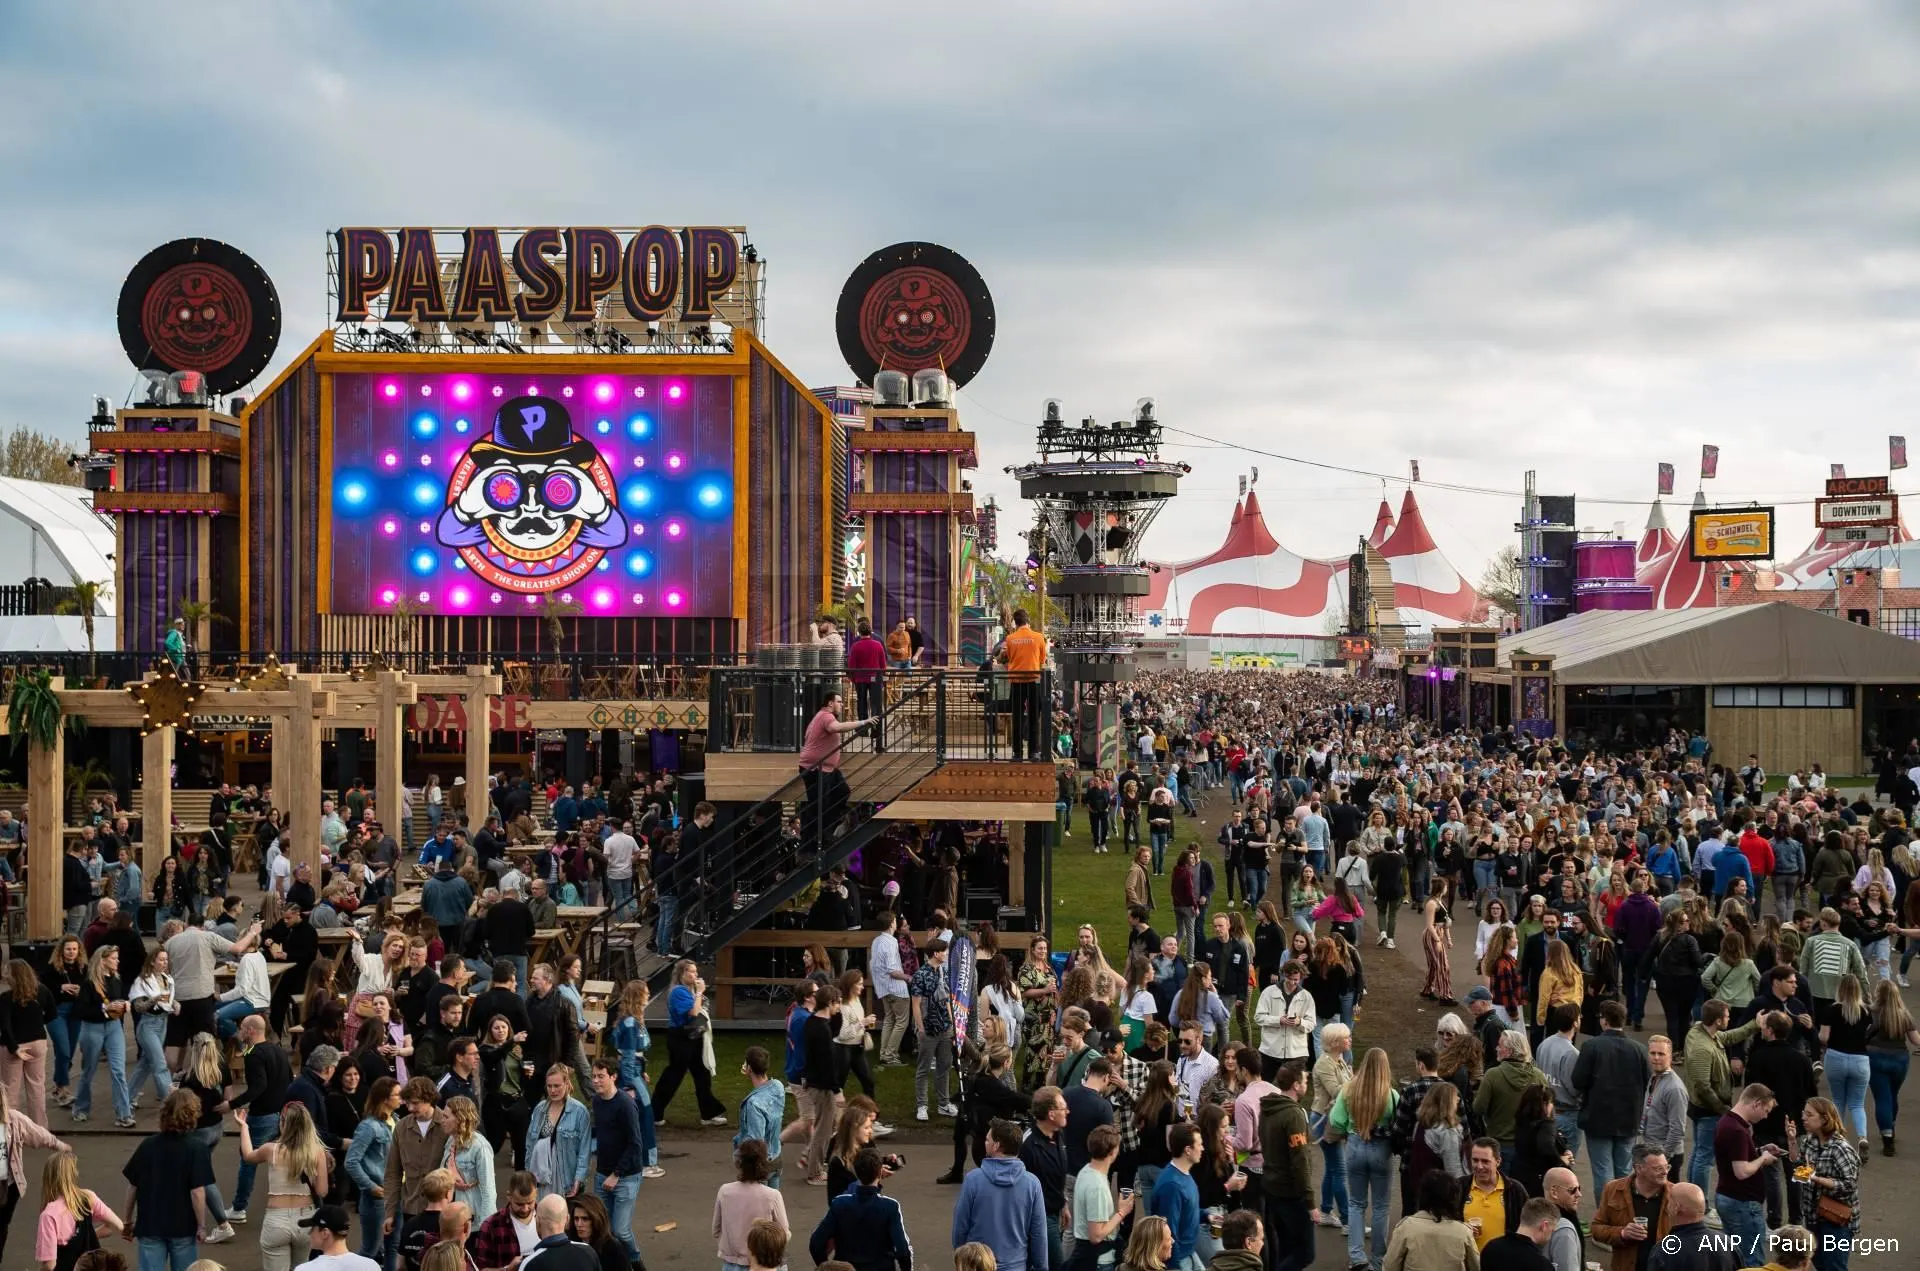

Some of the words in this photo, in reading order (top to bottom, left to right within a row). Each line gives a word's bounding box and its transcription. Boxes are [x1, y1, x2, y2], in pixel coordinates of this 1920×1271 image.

[335, 225, 738, 322] PAASPOP
[520, 405, 547, 444] P
[453, 457, 475, 497] REATEST
[1829, 480, 1886, 492] ARCADE
[1832, 505, 1881, 517] DOWNTOWN
[1717, 523, 1753, 537] SCHIJNDEL
[1846, 530, 1866, 540] OPEN
[464, 547, 486, 571] ARTH
[493, 572, 512, 585] THE
[513, 578, 561, 589] GREATEST
[562, 563, 588, 581] SHOW
[587, 549, 600, 564] ON
